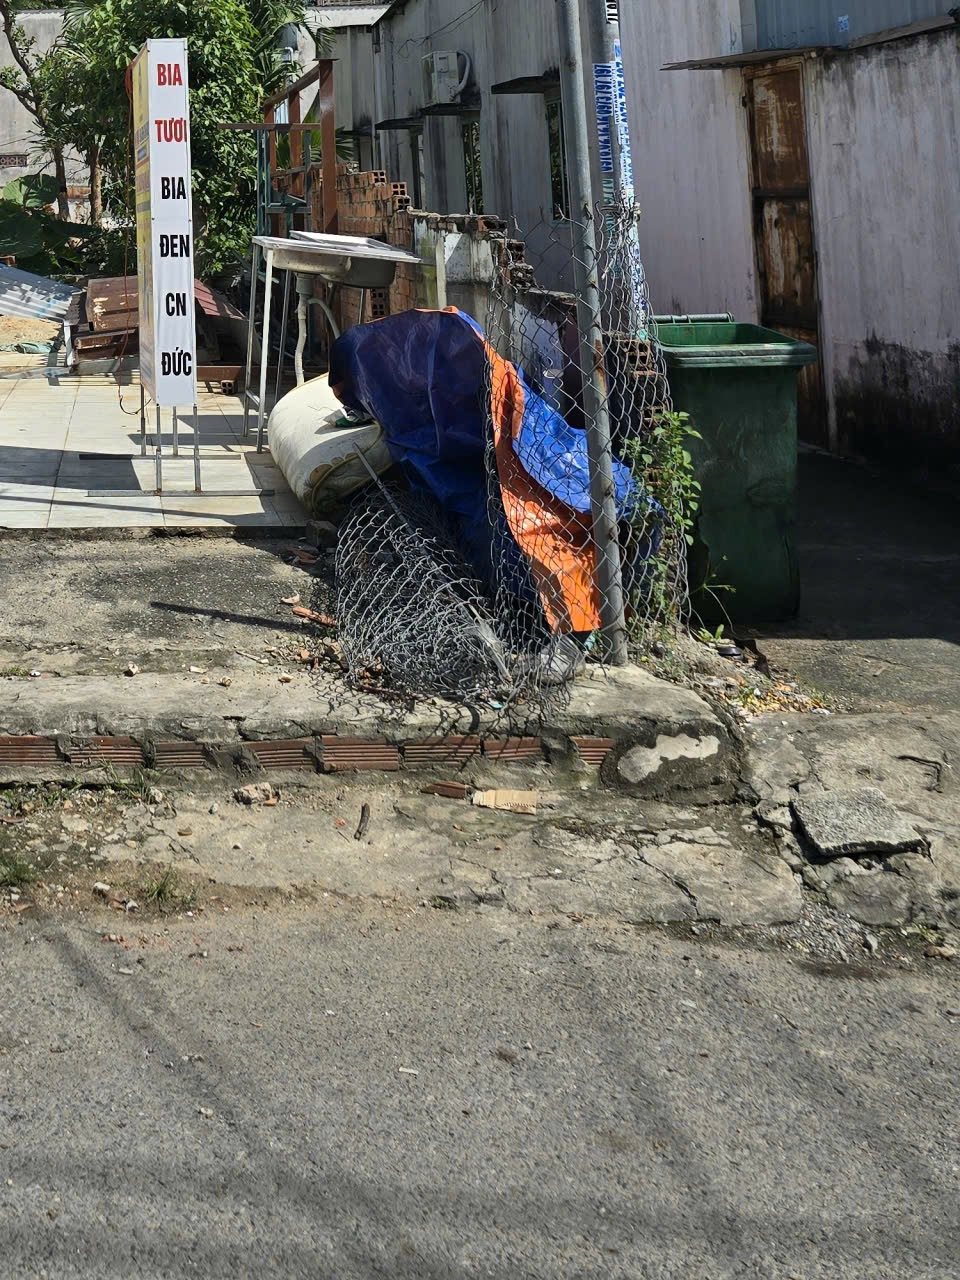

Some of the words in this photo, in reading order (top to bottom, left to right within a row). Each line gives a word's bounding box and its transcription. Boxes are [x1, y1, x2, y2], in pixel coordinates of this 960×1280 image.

[157, 64, 183, 86] BIA
[594, 64, 613, 115] 0973.797.197
[155, 117, 187, 143] TƯƠI
[161, 176, 187, 200] BIA
[159, 234, 190, 258] ĐEN
[165, 292, 187, 317] CN
[161, 346, 192, 376] ĐỨC
